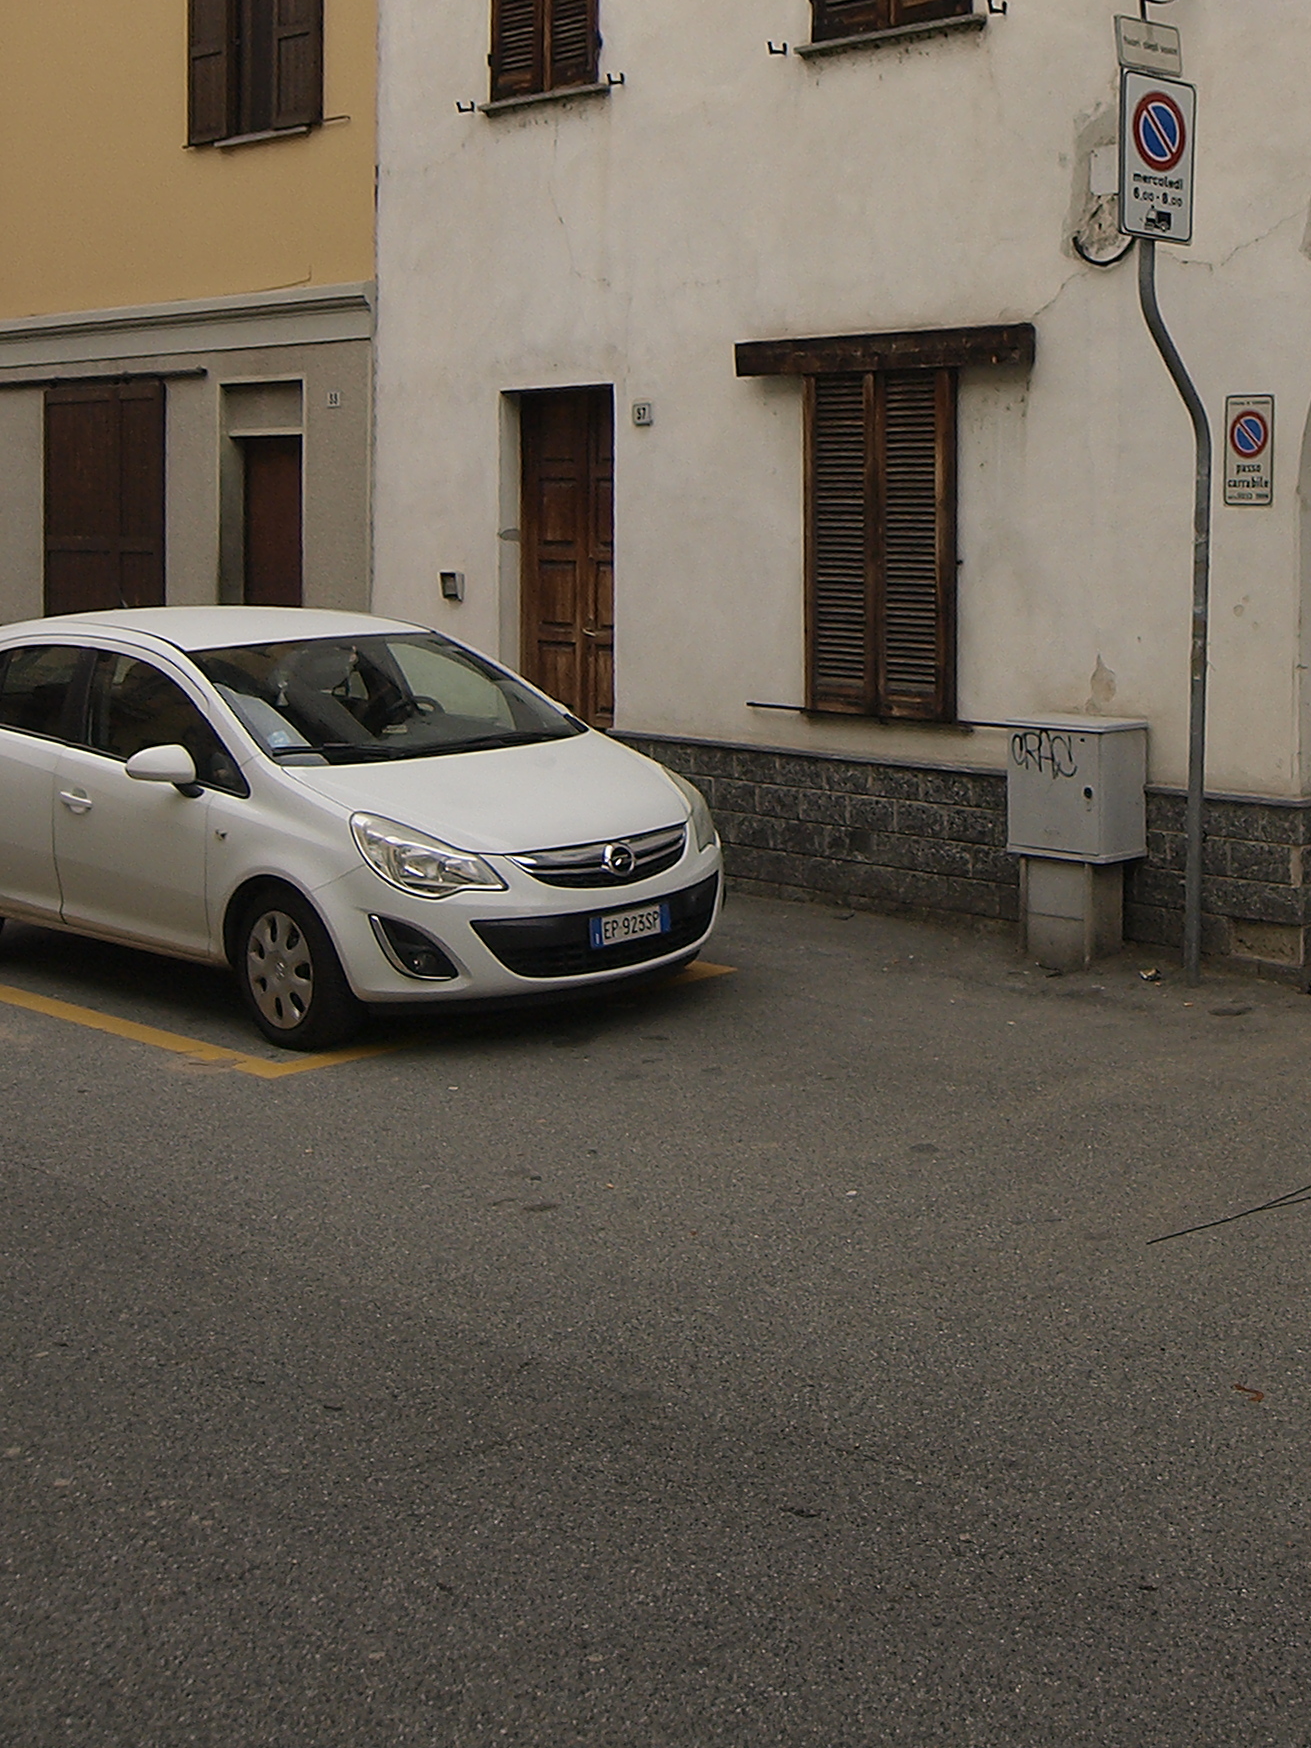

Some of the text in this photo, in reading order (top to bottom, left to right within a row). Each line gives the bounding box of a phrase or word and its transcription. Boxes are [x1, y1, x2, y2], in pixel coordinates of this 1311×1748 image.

[1236, 464, 1261, 475] passo
[1228, 476, 1269, 488] carrabile
[603, 910, 660, 939] EP 923SP
